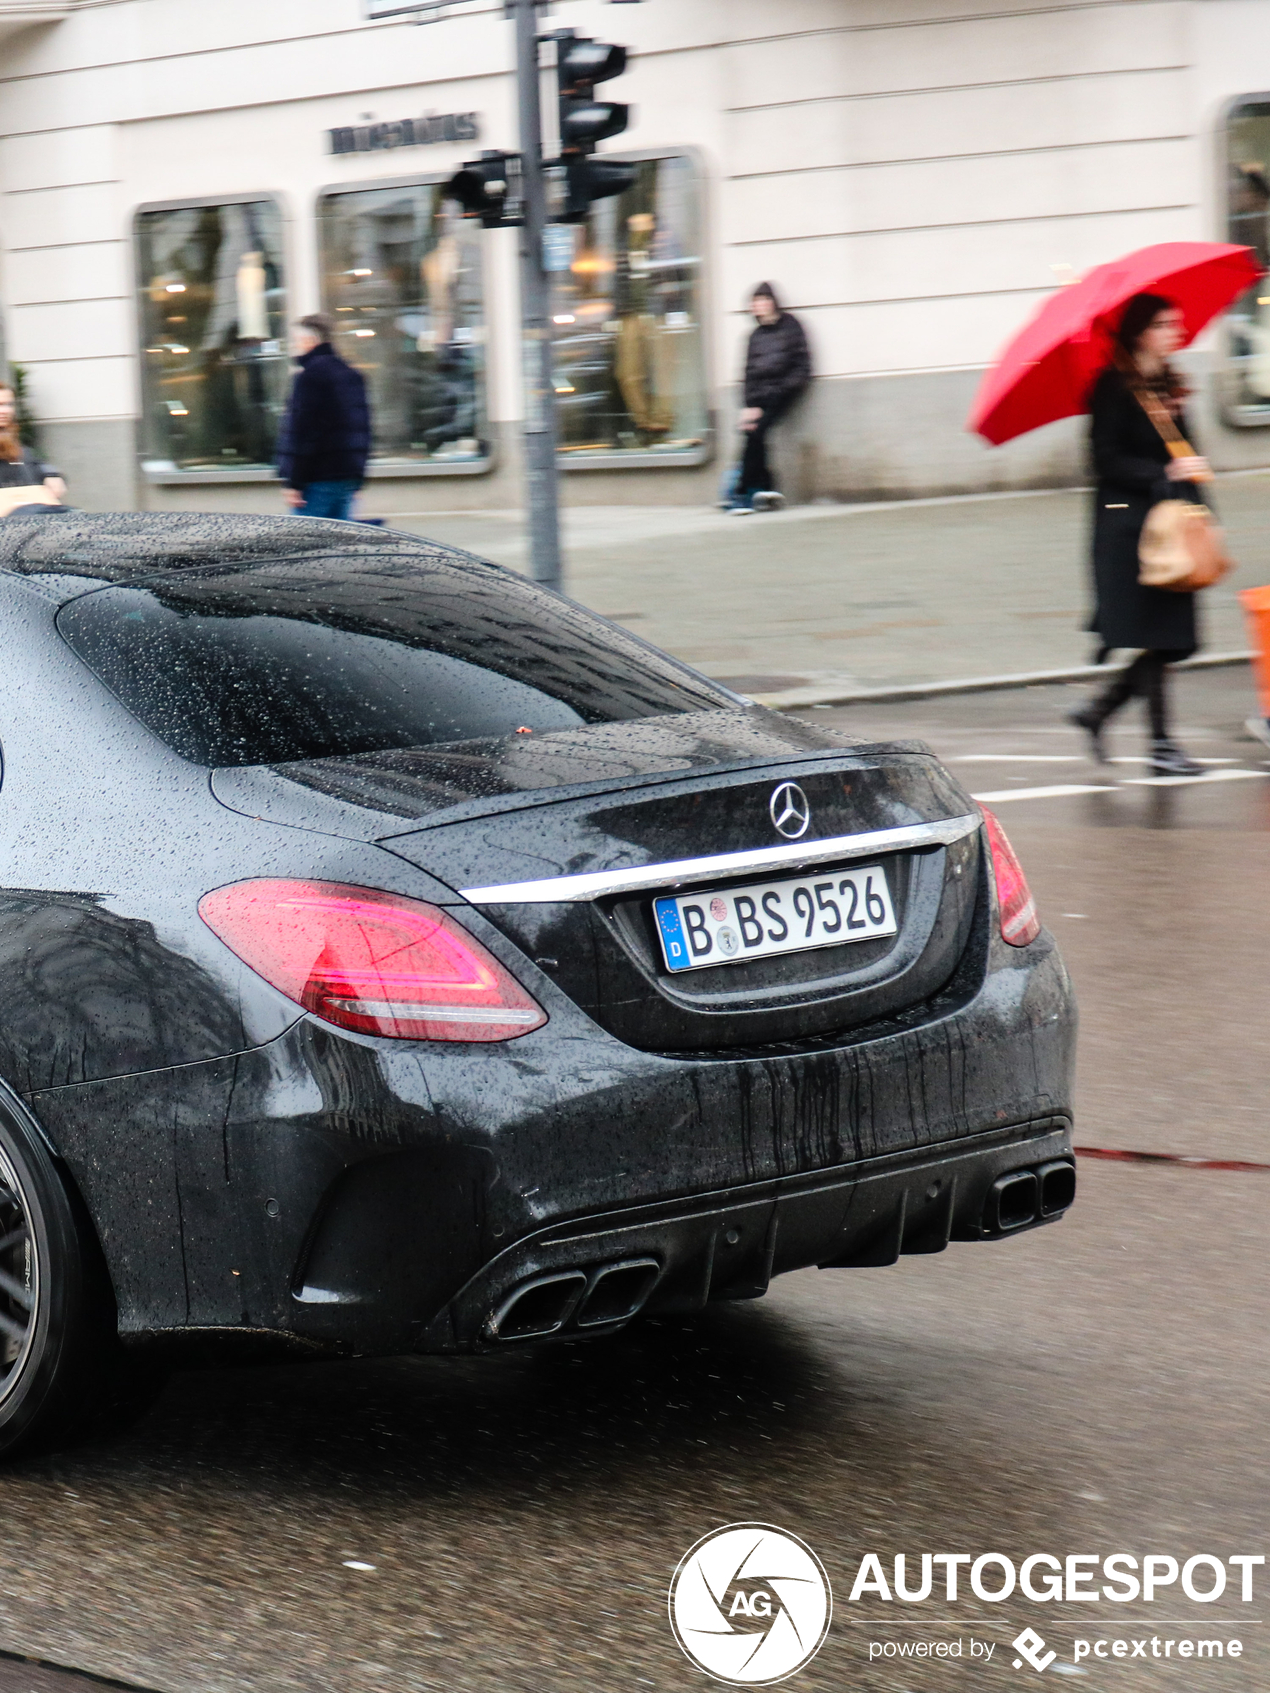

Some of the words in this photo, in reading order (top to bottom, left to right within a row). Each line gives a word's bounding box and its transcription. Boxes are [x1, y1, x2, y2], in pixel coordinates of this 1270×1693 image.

[682, 904, 713, 957] B
[733, 891, 788, 948] BS
[792, 875, 886, 938] 9526
[670, 941, 682, 957] D
